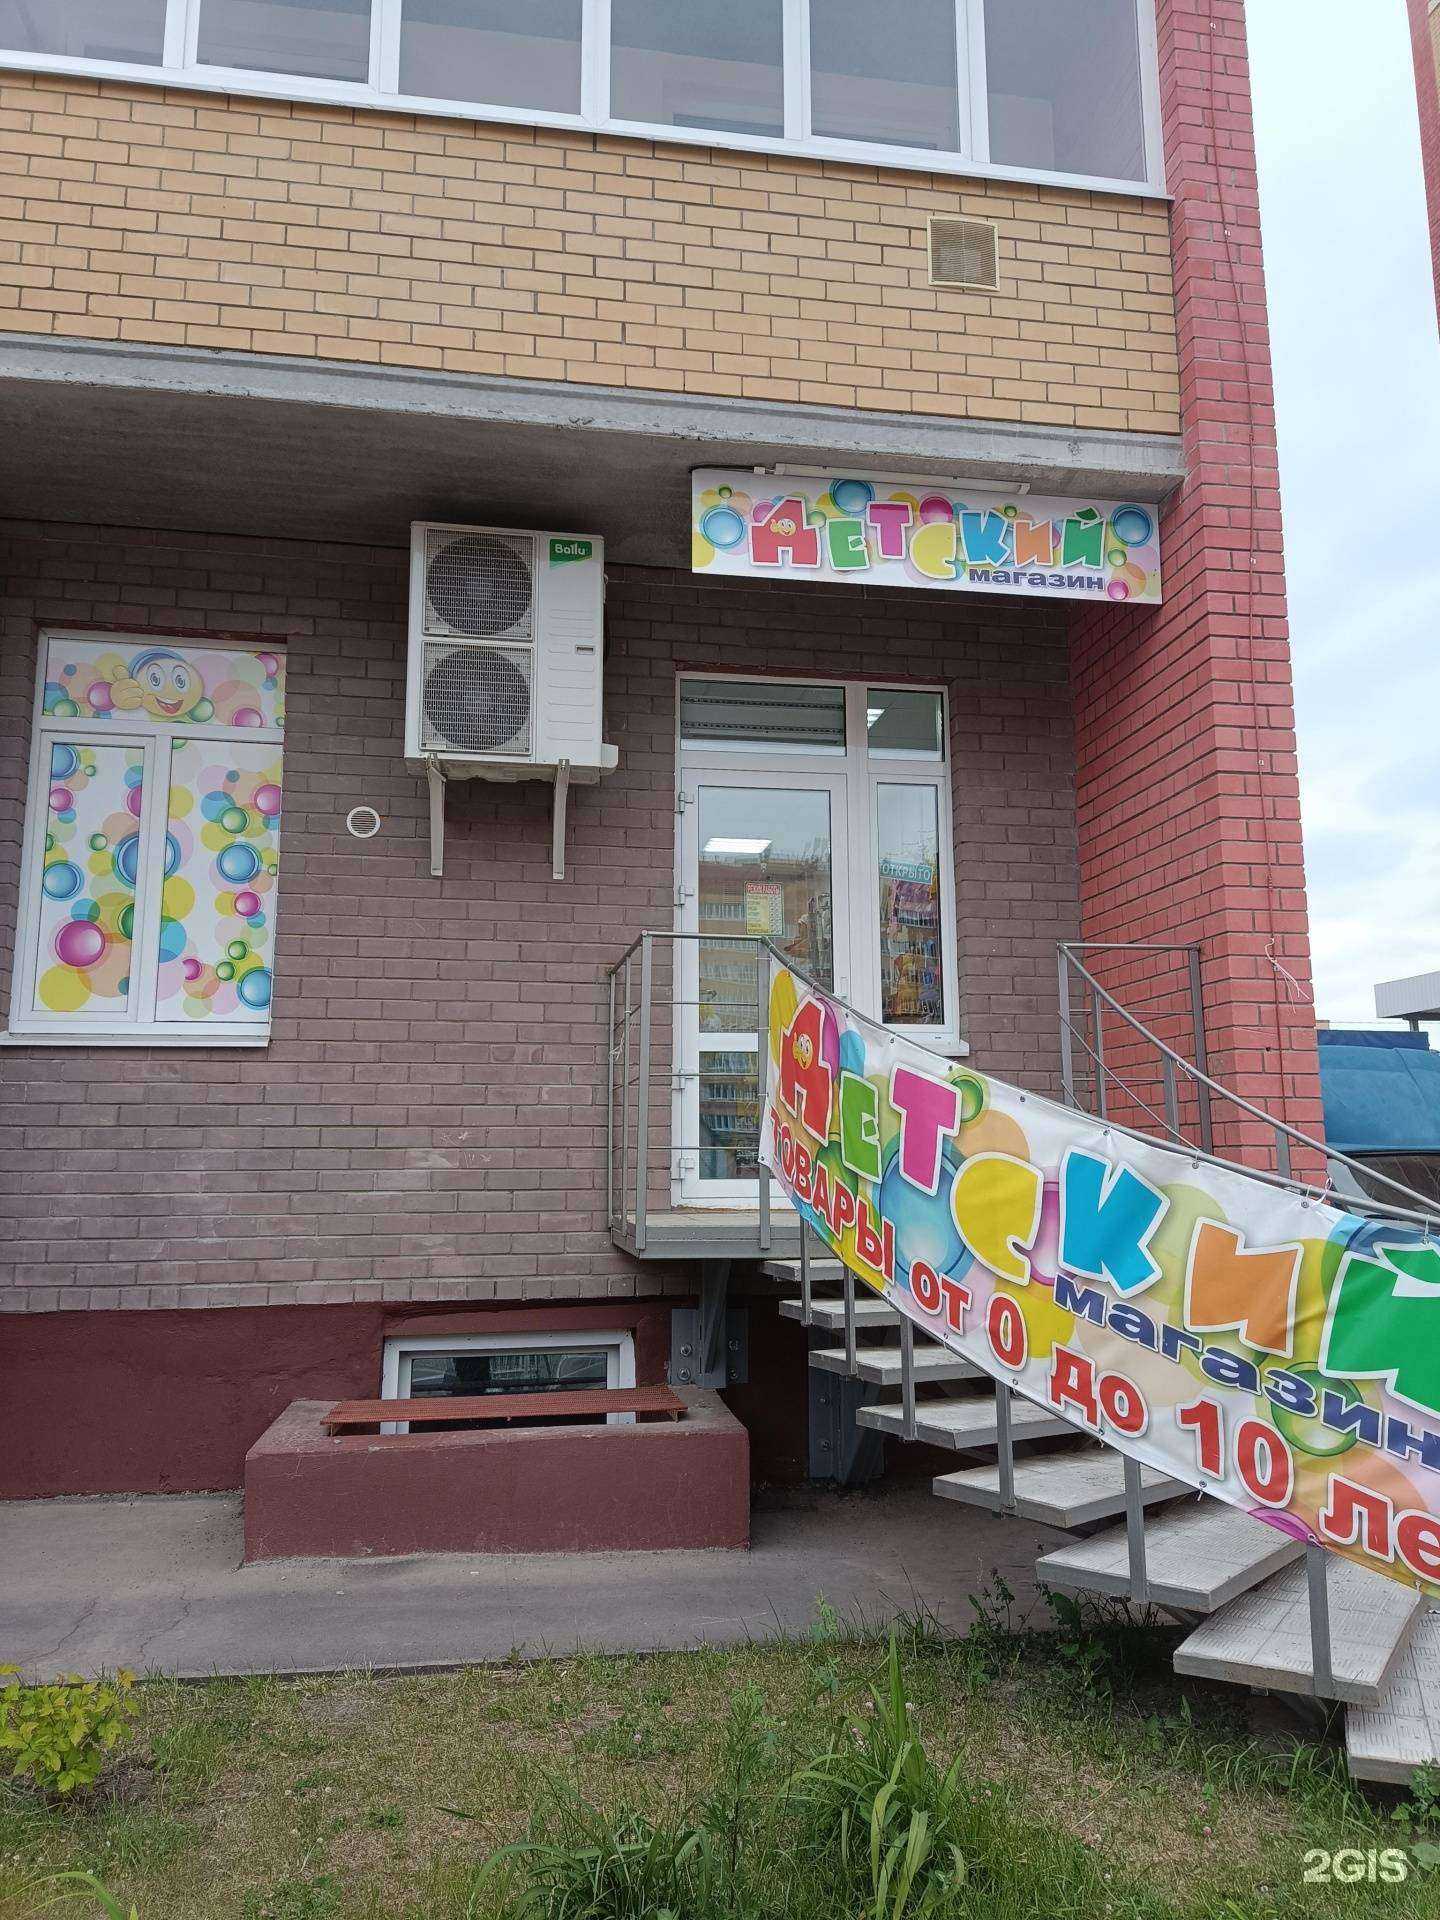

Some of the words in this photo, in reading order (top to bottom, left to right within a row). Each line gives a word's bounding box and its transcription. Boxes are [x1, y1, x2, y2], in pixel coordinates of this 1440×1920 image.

[555, 543, 586, 556] Ballu
[968, 567, 1106, 591] магазин
[882, 862, 931, 881] ОТКРЫТО
[769, 1106, 896, 1285] ТОВАРЫ
[986, 1291, 1028, 1372] 0
[1175, 1398, 1295, 1509] 10
[1053, 1273, 1440, 1475] магазин
